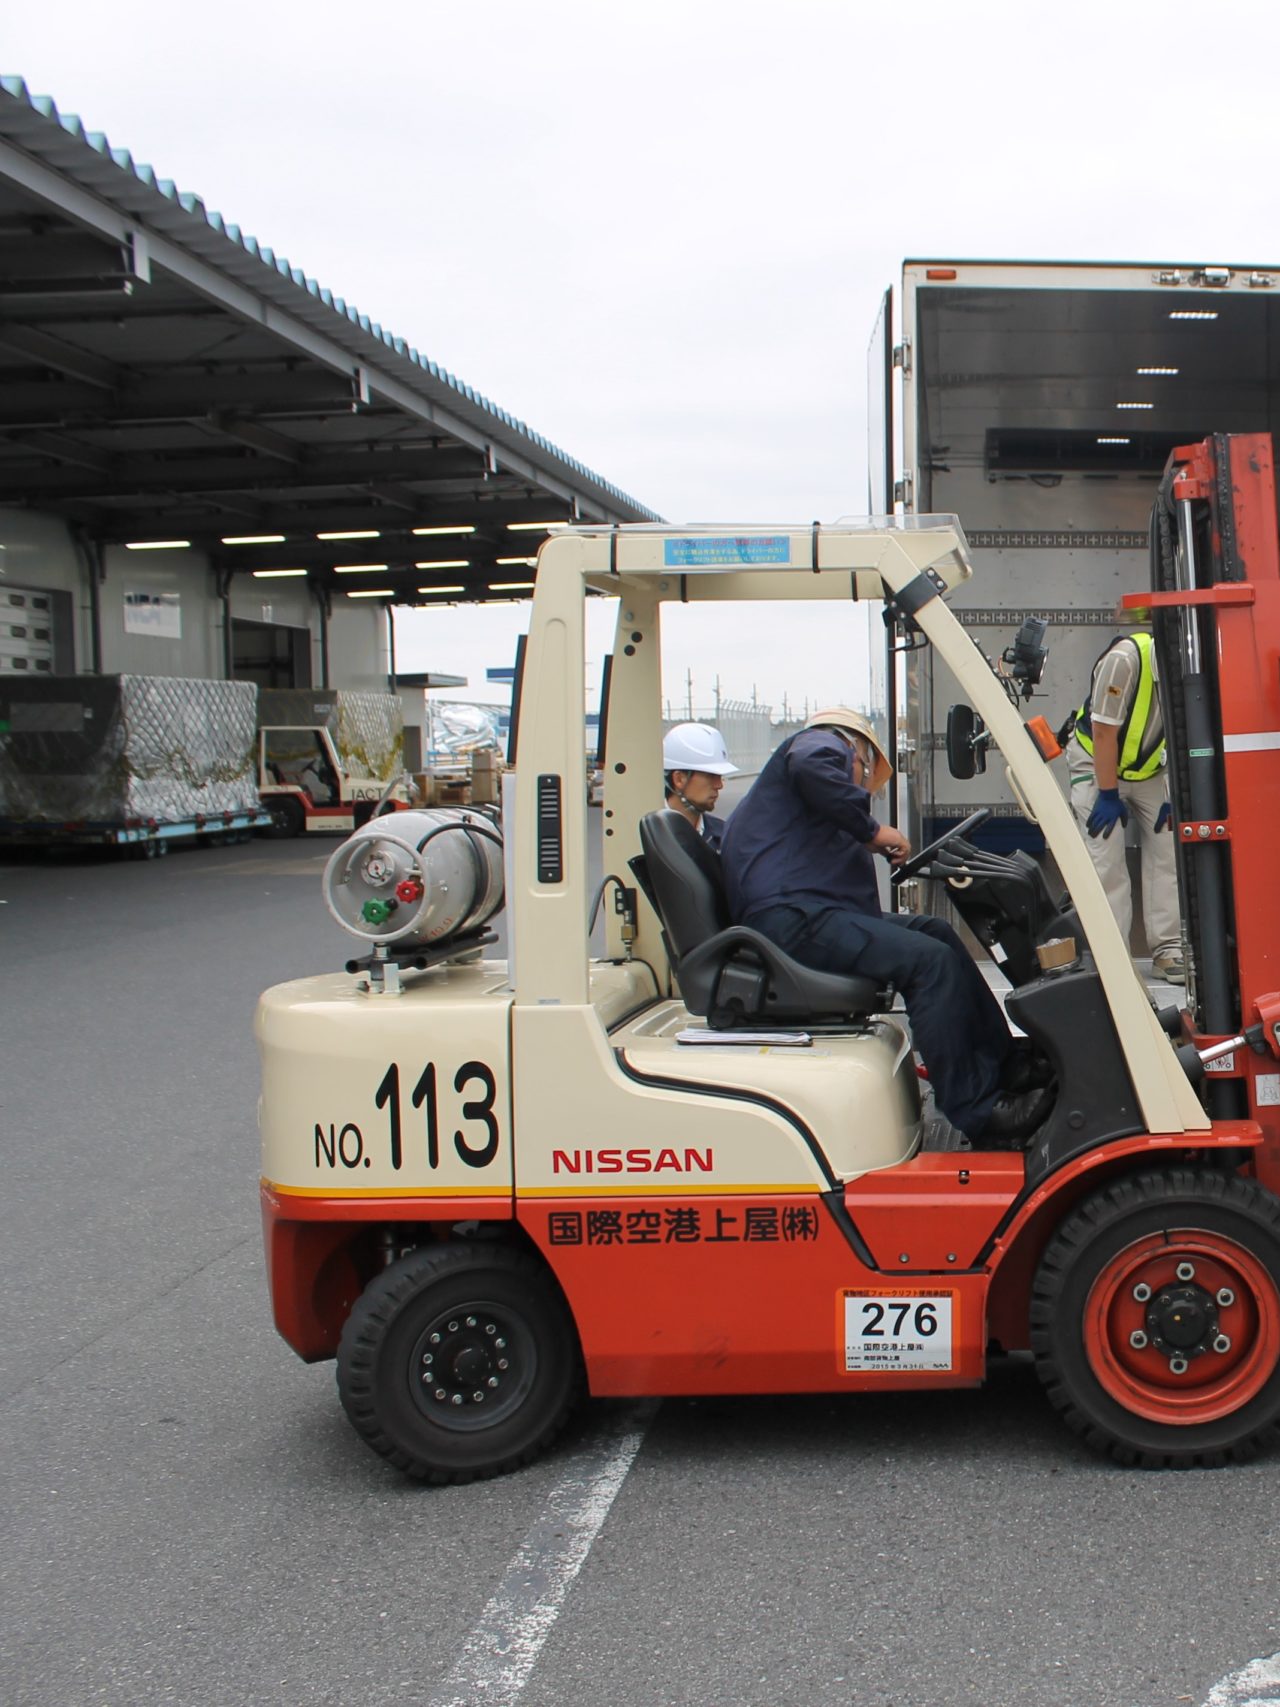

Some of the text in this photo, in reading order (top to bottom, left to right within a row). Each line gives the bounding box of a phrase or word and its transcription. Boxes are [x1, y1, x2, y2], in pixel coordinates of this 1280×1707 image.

[314, 1060, 499, 1170] NO. 113
[552, 1148, 713, 1174] NISSAN
[861, 1302, 938, 1337] 276
